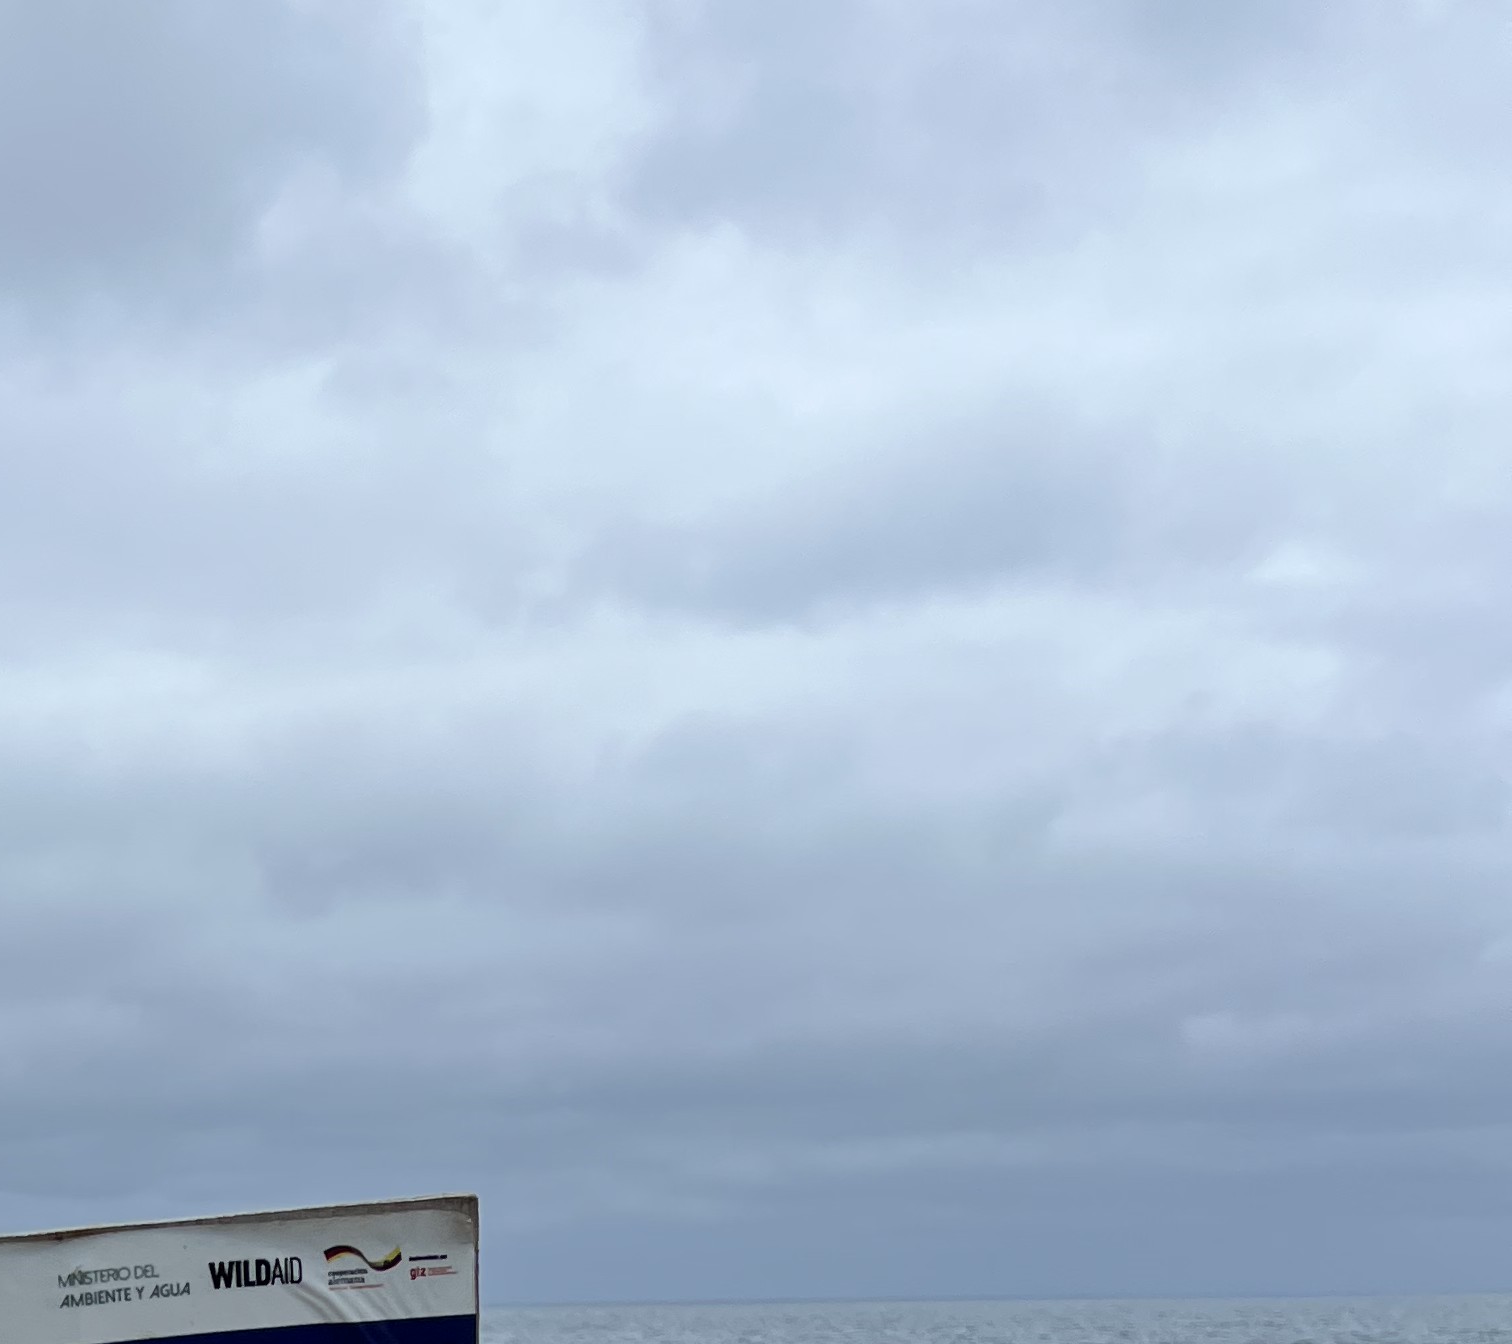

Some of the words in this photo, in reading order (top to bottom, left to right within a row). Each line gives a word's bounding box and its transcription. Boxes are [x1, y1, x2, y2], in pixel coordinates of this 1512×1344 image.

[57, 1264, 131, 1288] MINISTERIO
[134, 1264, 160, 1281] DEL
[208, 1256, 303, 1289] WILDAID
[59, 1287, 132, 1309] AMBIENTE
[135, 1286, 145, 1300] Y
[149, 1282, 191, 1299] AGUA
